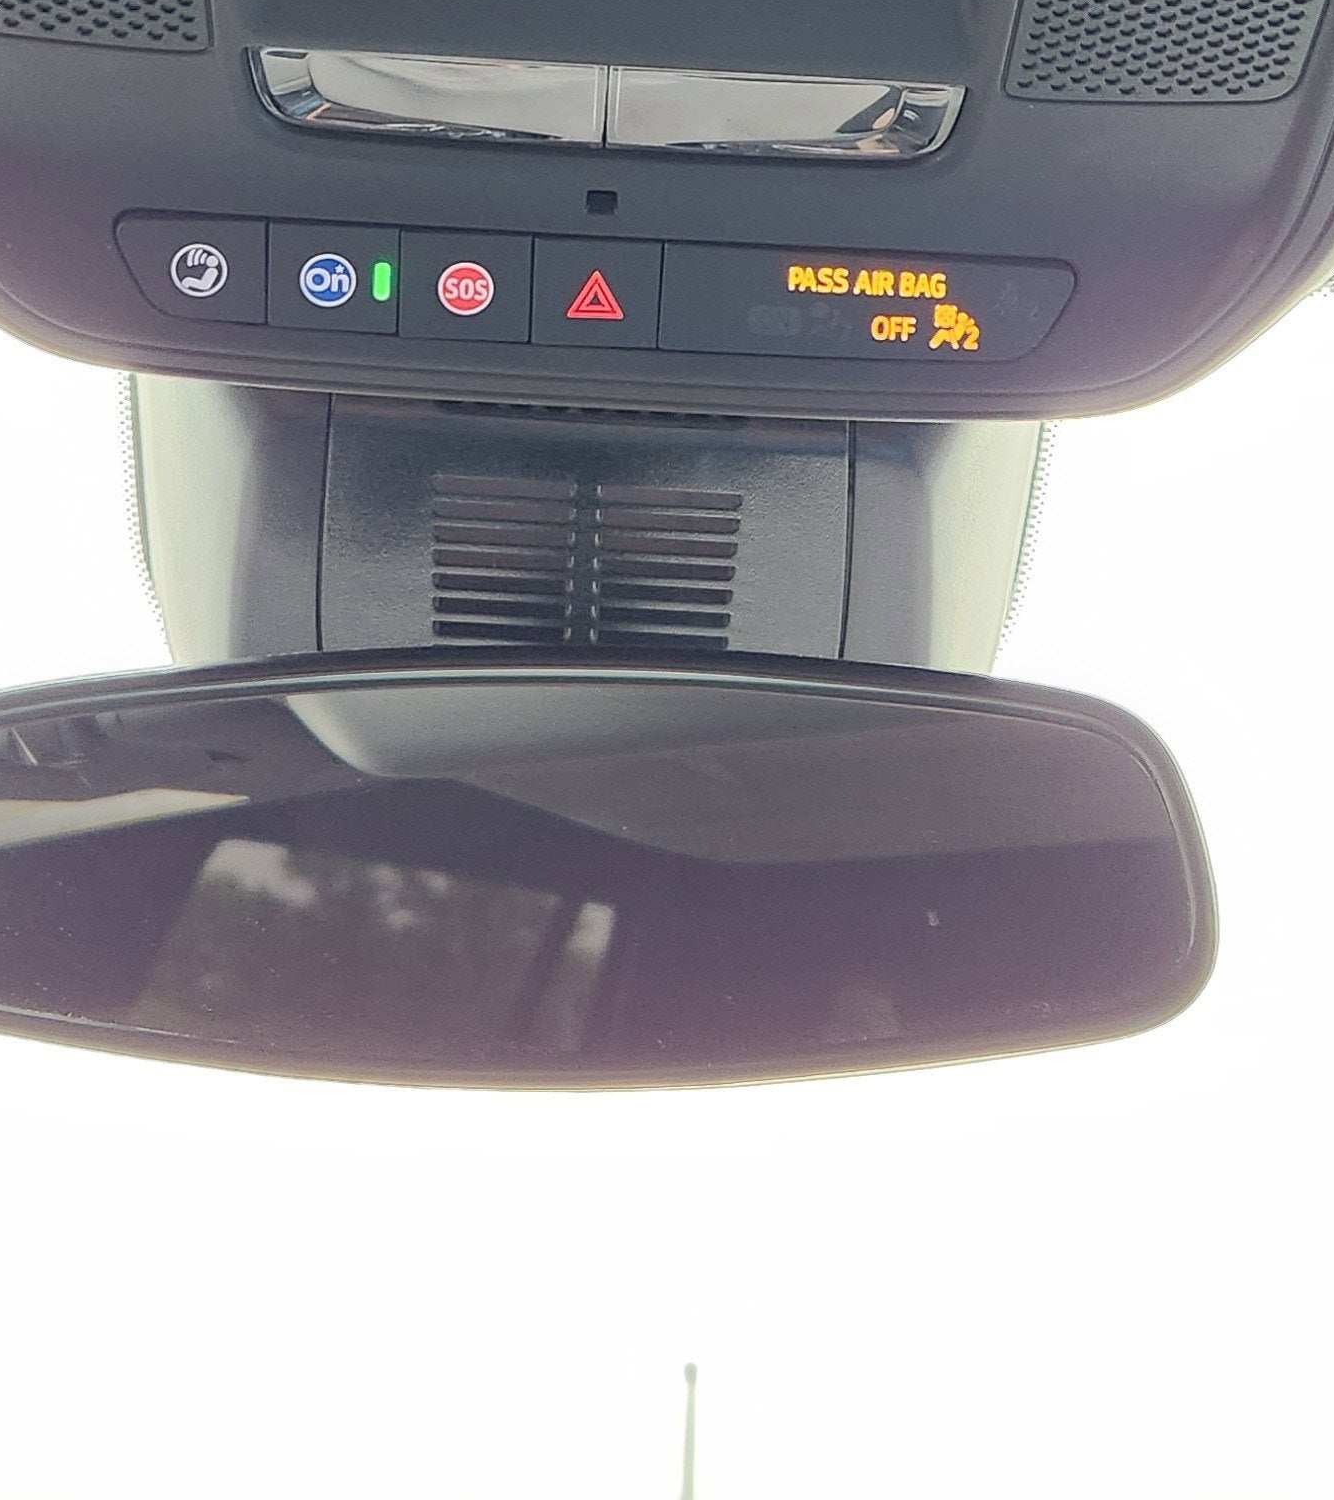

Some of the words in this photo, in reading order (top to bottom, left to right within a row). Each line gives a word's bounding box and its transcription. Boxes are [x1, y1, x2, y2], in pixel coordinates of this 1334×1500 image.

[305, 267, 350, 293] On
[444, 278, 489, 301] SOS
[787, 265, 850, 294] PASS
[853, 269, 895, 297] AIR
[898, 271, 947, 299] BAG
[870, 315, 918, 342] OFF
